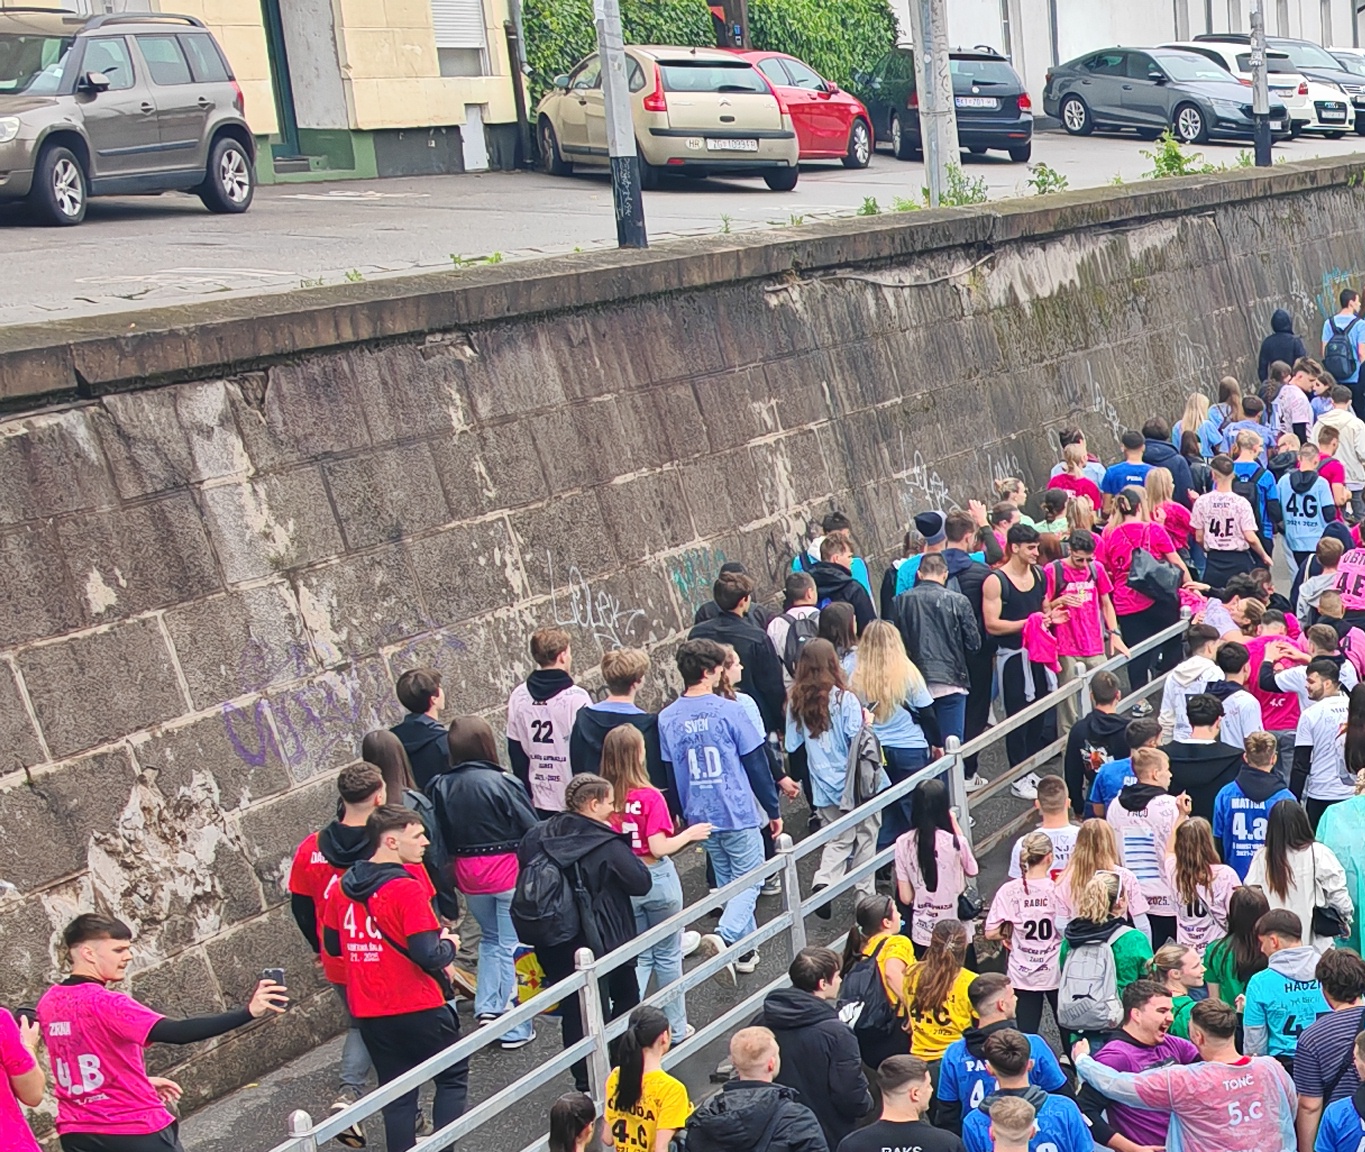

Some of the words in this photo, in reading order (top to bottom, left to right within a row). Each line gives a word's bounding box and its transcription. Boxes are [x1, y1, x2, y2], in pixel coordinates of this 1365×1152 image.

[687, 138, 700, 148] HR
[1286, 494, 1318, 520] 4.G
[1209, 517, 1235, 538] 4.E
[1336, 571, 1365, 598] 4.E
[531, 720, 555, 744] 22
[684, 720, 709, 734] SVEN
[686, 747, 721, 780] 4.D
[1232, 812, 1266, 841] 4.a
[1024, 897, 1049, 909] RABIĆ
[1023, 919, 1053, 941] 20
[613, 1120, 648, 1147] 4.C
